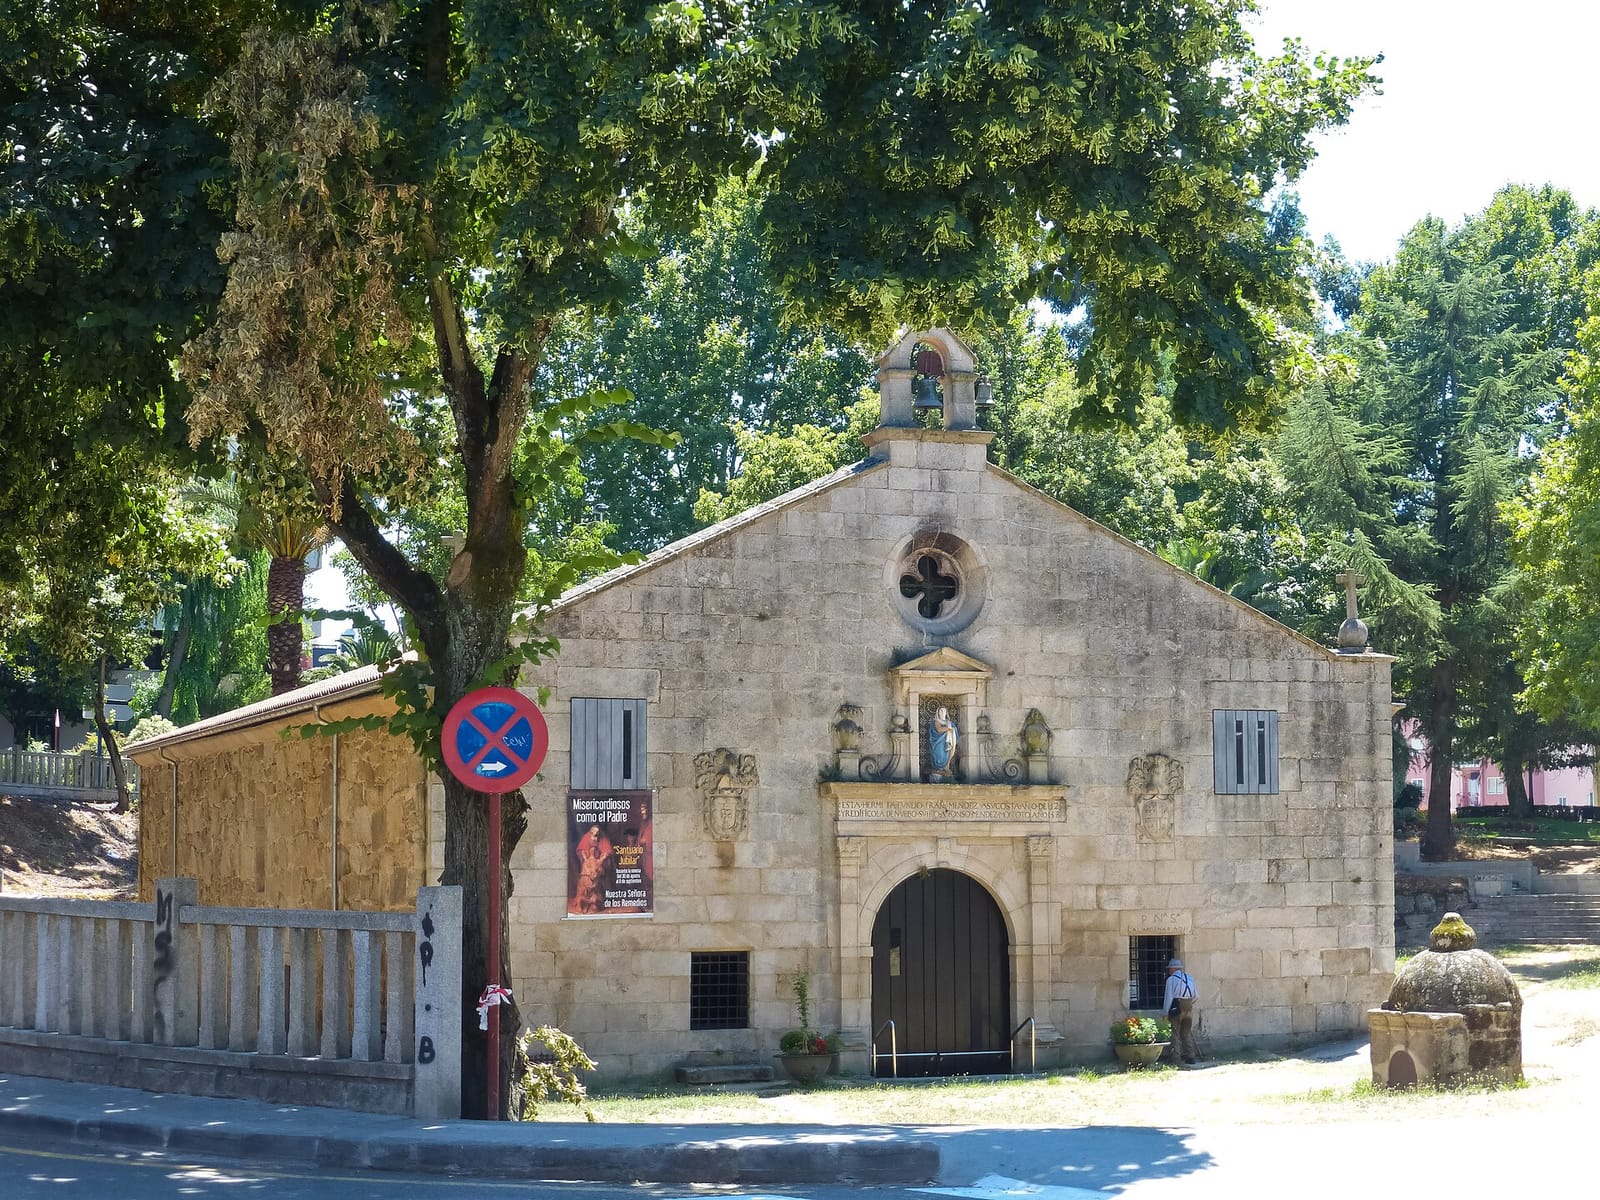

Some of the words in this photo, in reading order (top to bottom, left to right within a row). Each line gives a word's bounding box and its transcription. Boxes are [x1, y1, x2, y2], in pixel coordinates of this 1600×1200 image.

[572, 798, 631, 810] Misericordiosos
[576, 812, 597, 823] como
[598, 810, 605, 823] el
[606, 810, 628, 823] Padre
[605, 889, 627, 898] Nuestra
[627, 888, 646, 898] Señora
[604, 898, 611, 908] de
[611, 898, 621, 908] los
[621, 898, 648, 908] Remedios
